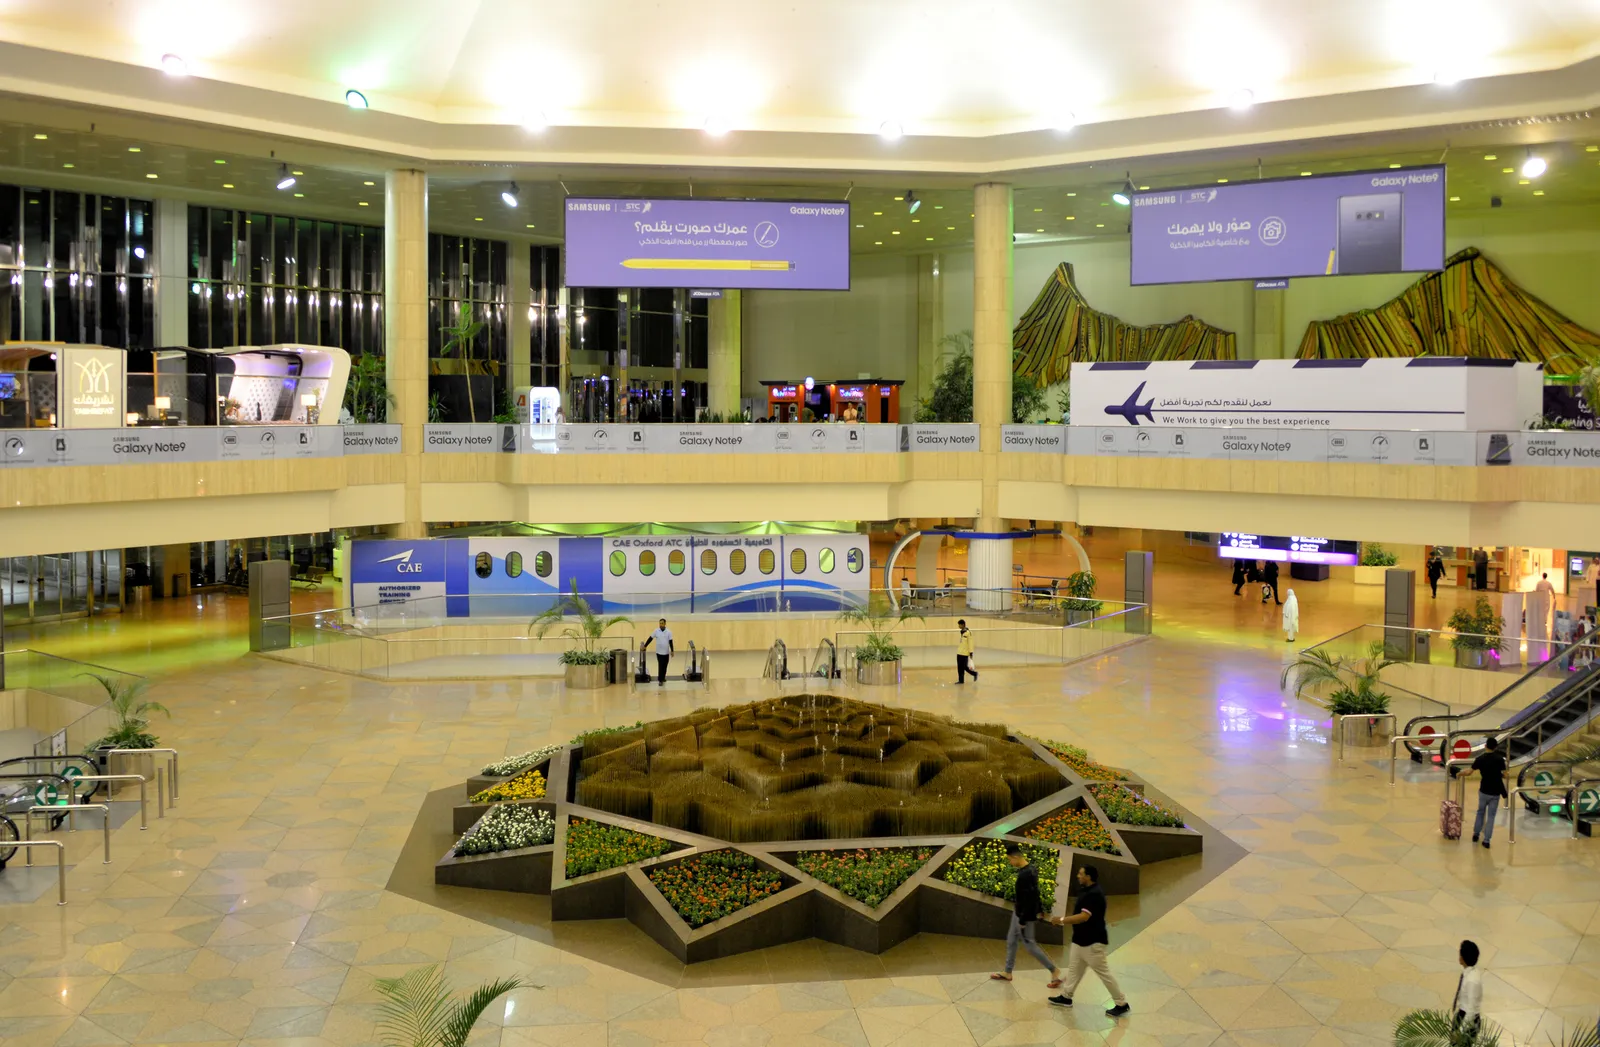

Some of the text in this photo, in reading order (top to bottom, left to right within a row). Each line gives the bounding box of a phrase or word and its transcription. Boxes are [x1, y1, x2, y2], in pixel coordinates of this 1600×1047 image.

[1371, 173, 1439, 187] Galaxy Note9
[1135, 196, 1176, 206] SAMSUNG
[1191, 192, 1206, 200] STC
[568, 203, 611, 211] SAMSUNG
[790, 206, 845, 216] Galaxy Note9
[675, 222, 711, 235] صورت
[714, 222, 748, 235] عمرك
[1168, 223, 1205, 236] يهمك
[1208, 221, 1223, 233] ولا
[1183, 399, 1204, 408] تجربة
[1205, 399, 1222, 408] لكم
[1223, 399, 1248, 408] لنقدم
[1163, 416, 1175, 424] We
[1177, 416, 1197, 424] Work
[1210, 417, 1227, 426] give
[1246, 417, 1260, 425] the
[1263, 417, 1280, 425] best
[1283, 418, 1330, 427] experience
[343, 436, 398, 447] Galaxy Note9
[428, 436, 492, 446] Galaxy Note9
[679, 437, 743, 447] Galaxy Note9
[917, 435, 975, 445] Galaxy Note9
[1005, 436, 1059, 446] Galaxy Note9
[113, 442, 186, 455] Galaxy Note9
[1222, 441, 1291, 453] Galaxy Note9
[1527, 446, 1571, 459] Galaxy
[612, 539, 631, 547] CAE
[633, 539, 663, 547] Oxford
[397, 563, 423, 573] CAE
